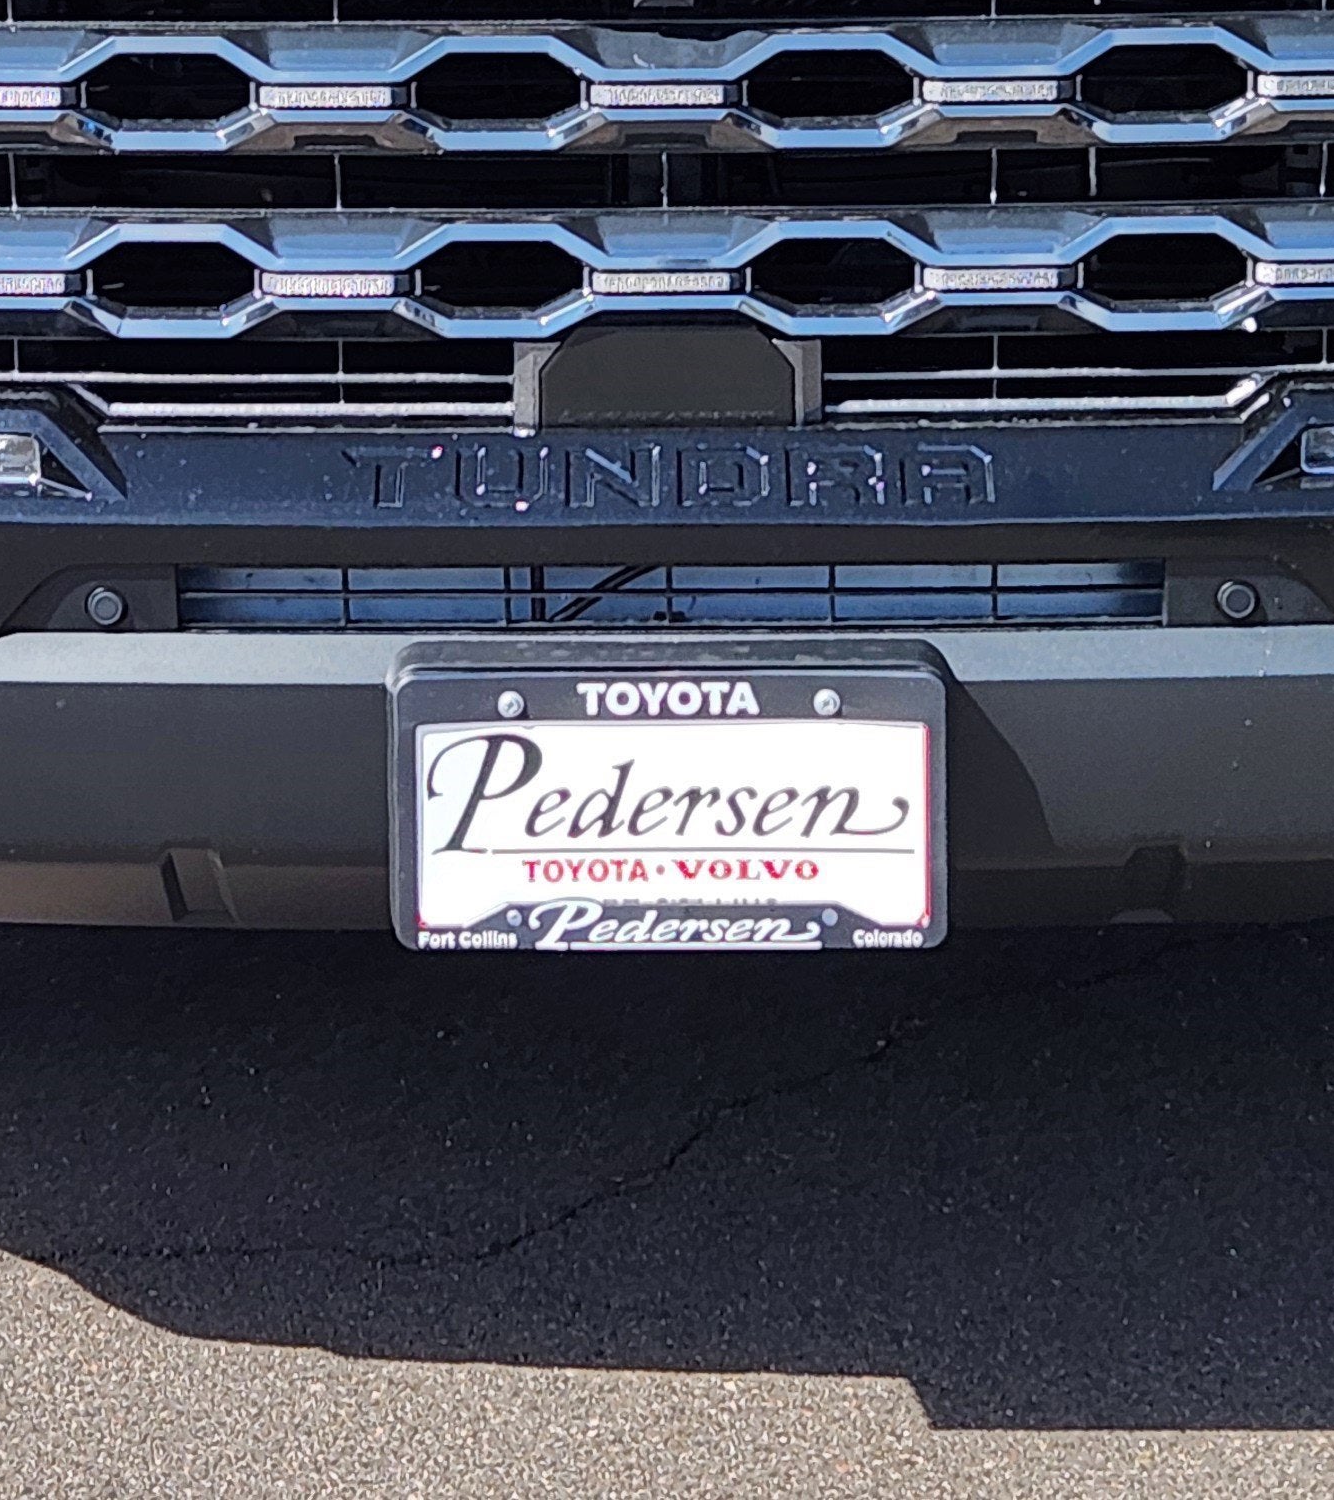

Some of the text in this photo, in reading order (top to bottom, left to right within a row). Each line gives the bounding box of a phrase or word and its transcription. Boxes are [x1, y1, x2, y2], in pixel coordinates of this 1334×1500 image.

[343, 443, 998, 507] TUNDRA
[577, 681, 760, 717] TOYOTA
[427, 732, 911, 853] Pedersen
[522, 858, 820, 883] TOYOTA VOLVO
[418, 930, 517, 949] Fort Collins
[528, 897, 823, 949] Pedersen
[852, 928, 924, 948] Colorado
